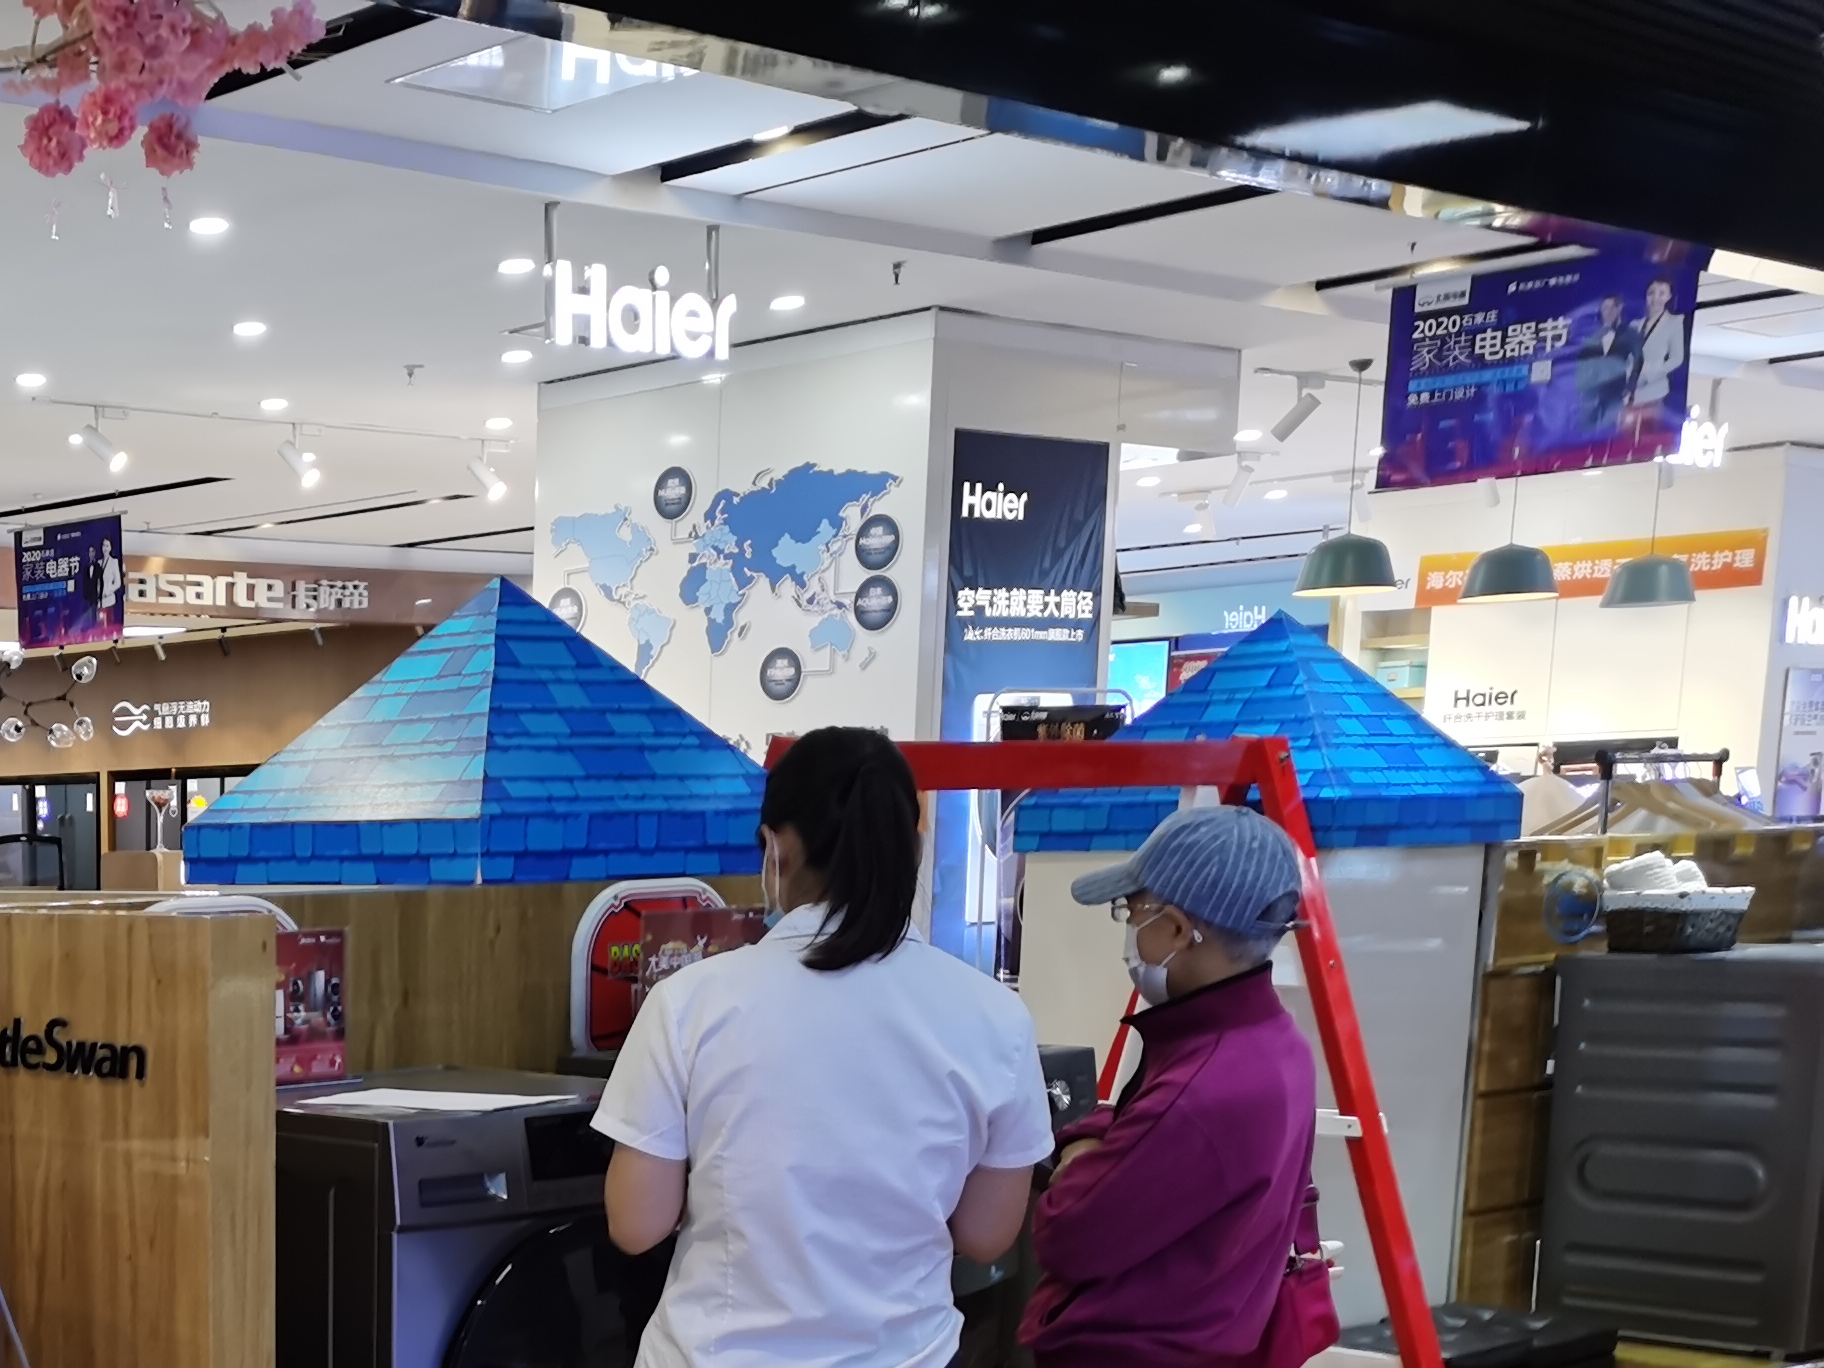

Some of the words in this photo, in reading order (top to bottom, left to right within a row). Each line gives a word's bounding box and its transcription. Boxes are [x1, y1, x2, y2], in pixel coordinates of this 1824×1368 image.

[555, 259, 737, 360] Haier
[1409, 315, 1573, 372] 家装电器节
[1666, 404, 1729, 467] ier
[961, 481, 1028, 520] Haier
[22, 555, 81, 581] 家装电器节
[126, 571, 285, 608] asarte
[290, 579, 369, 612] 卡萨帝
[956, 587, 1093, 619] 空气洗就要大筒径
[1453, 686, 1518, 708] Haier
